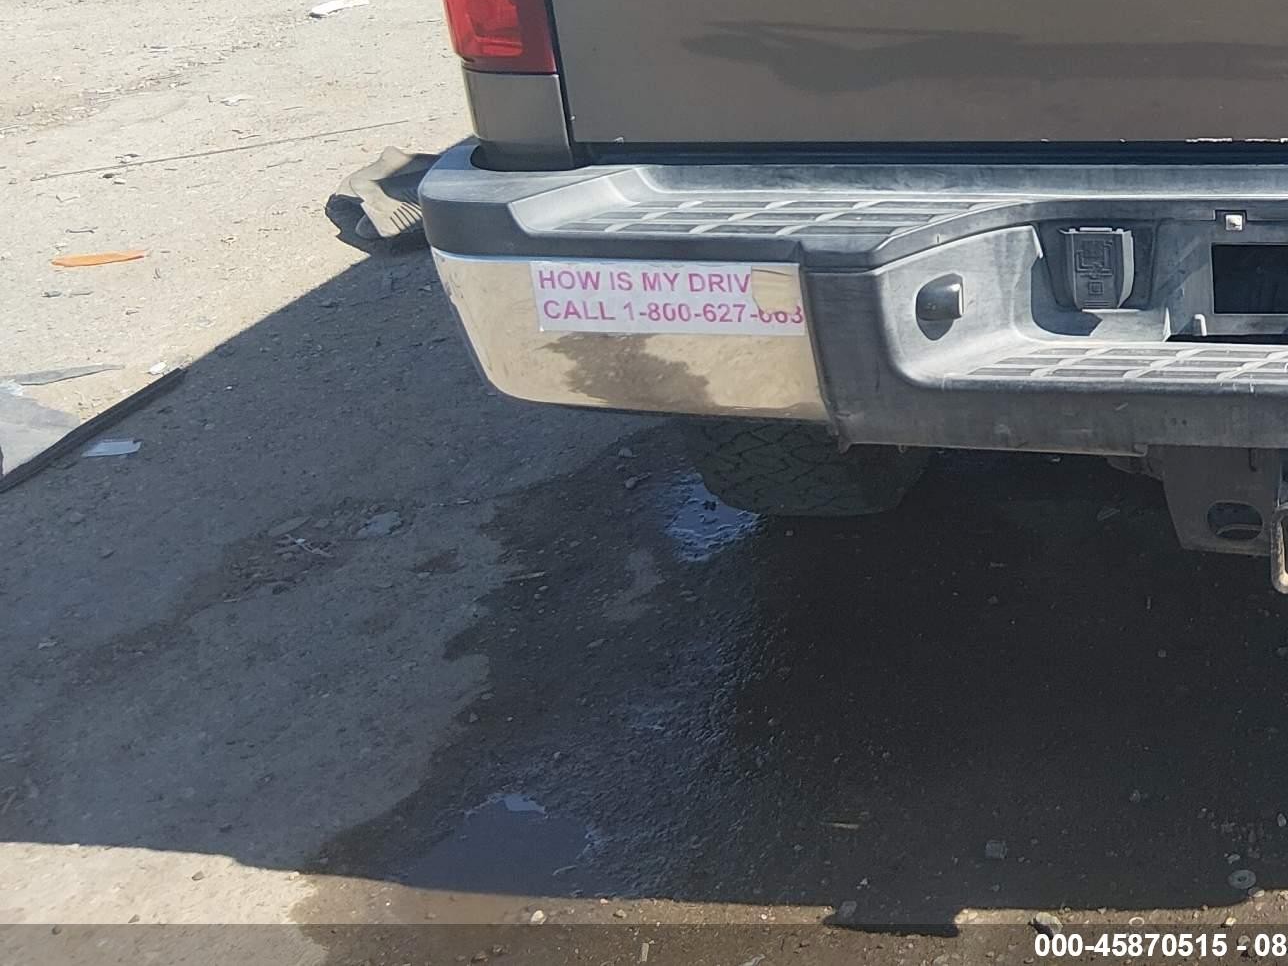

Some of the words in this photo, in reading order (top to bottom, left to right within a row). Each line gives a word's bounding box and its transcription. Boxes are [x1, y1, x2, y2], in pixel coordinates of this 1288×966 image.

[539, 270, 600, 291] HOW
[610, 271, 633, 291] IS
[642, 272, 680, 292] MY
[688, 272, 751, 293] DRIV
[543, 300, 616, 321] CALL
